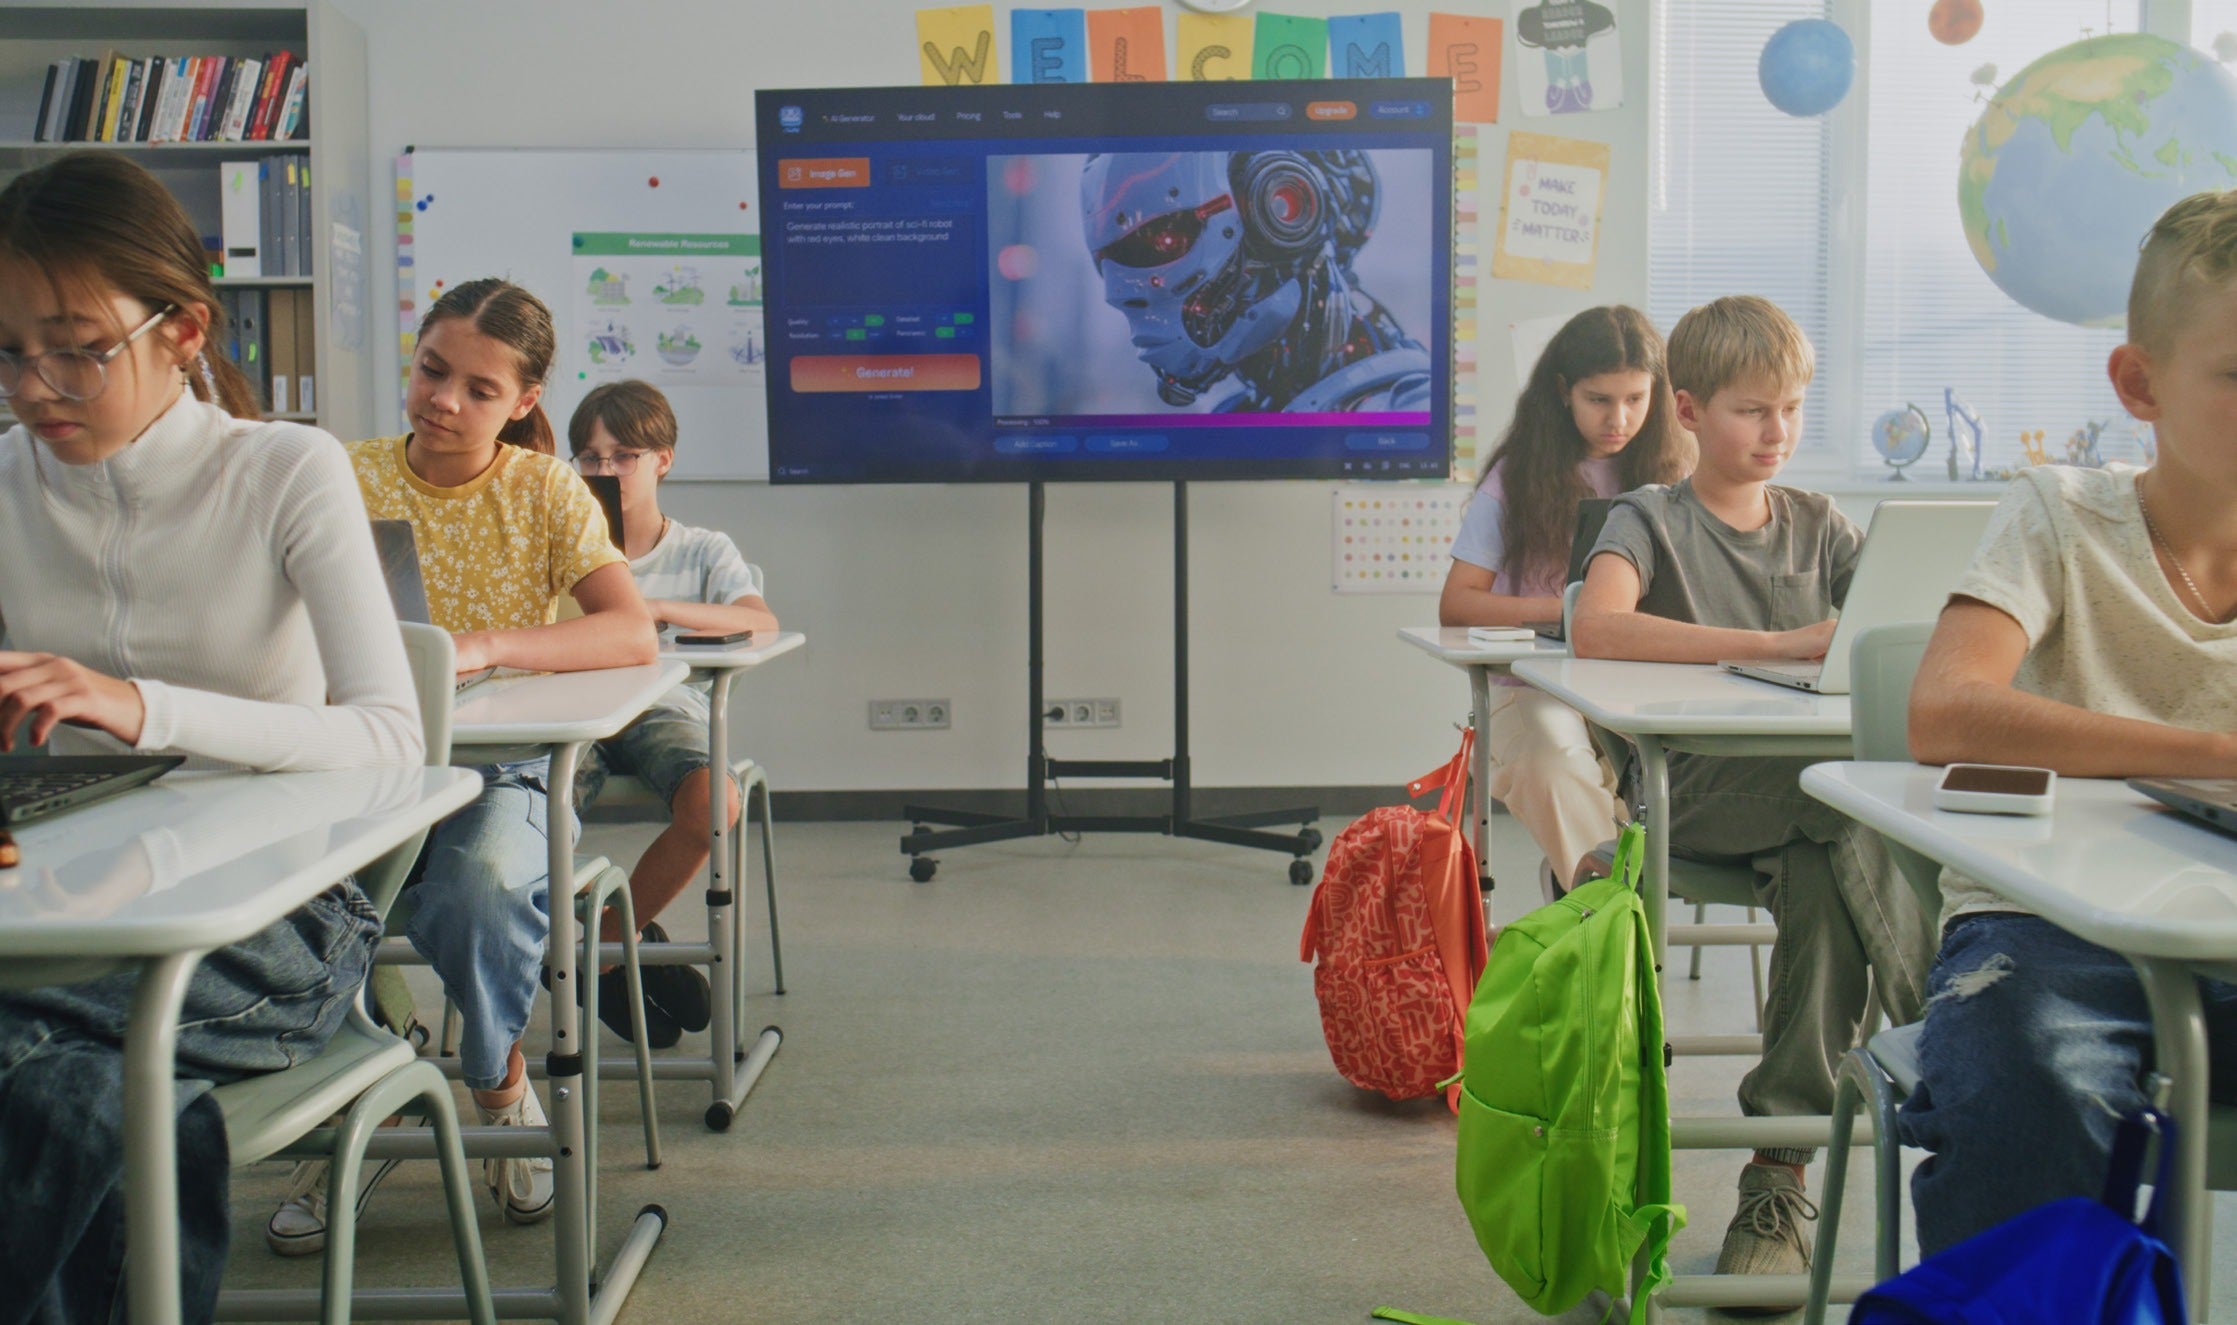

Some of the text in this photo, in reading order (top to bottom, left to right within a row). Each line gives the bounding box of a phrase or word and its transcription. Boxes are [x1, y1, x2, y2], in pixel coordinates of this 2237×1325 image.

[1212, 107, 1239, 117] Search
[1315, 106, 1349, 117] Upgrade
[1378, 104, 1409, 114] Account
[840, 114, 875, 122] Generator
[897, 112, 936, 122] Your cloud
[956, 111, 982, 122] Pricing
[1003, 111, 1023, 119] Tools
[1043, 110, 1061, 120] Help
[809, 167, 856, 180] Image Gen
[1538, 178, 1577, 195] MAKE
[783, 202, 804, 211] Enter
[805, 202, 823, 212] your
[1531, 199, 1578, 219] TODAY
[787, 218, 953, 232] Generate realistic portrait of sci-fi robot
[787, 231, 950, 244] with red eyes, white clean background
[1521, 222, 1580, 243] MATTER
[628, 238, 731, 249] Renewable Resources
[855, 366, 915, 379] Generate!
[1014, 438, 1029, 449] Add
[1110, 438, 1127, 448] Save
